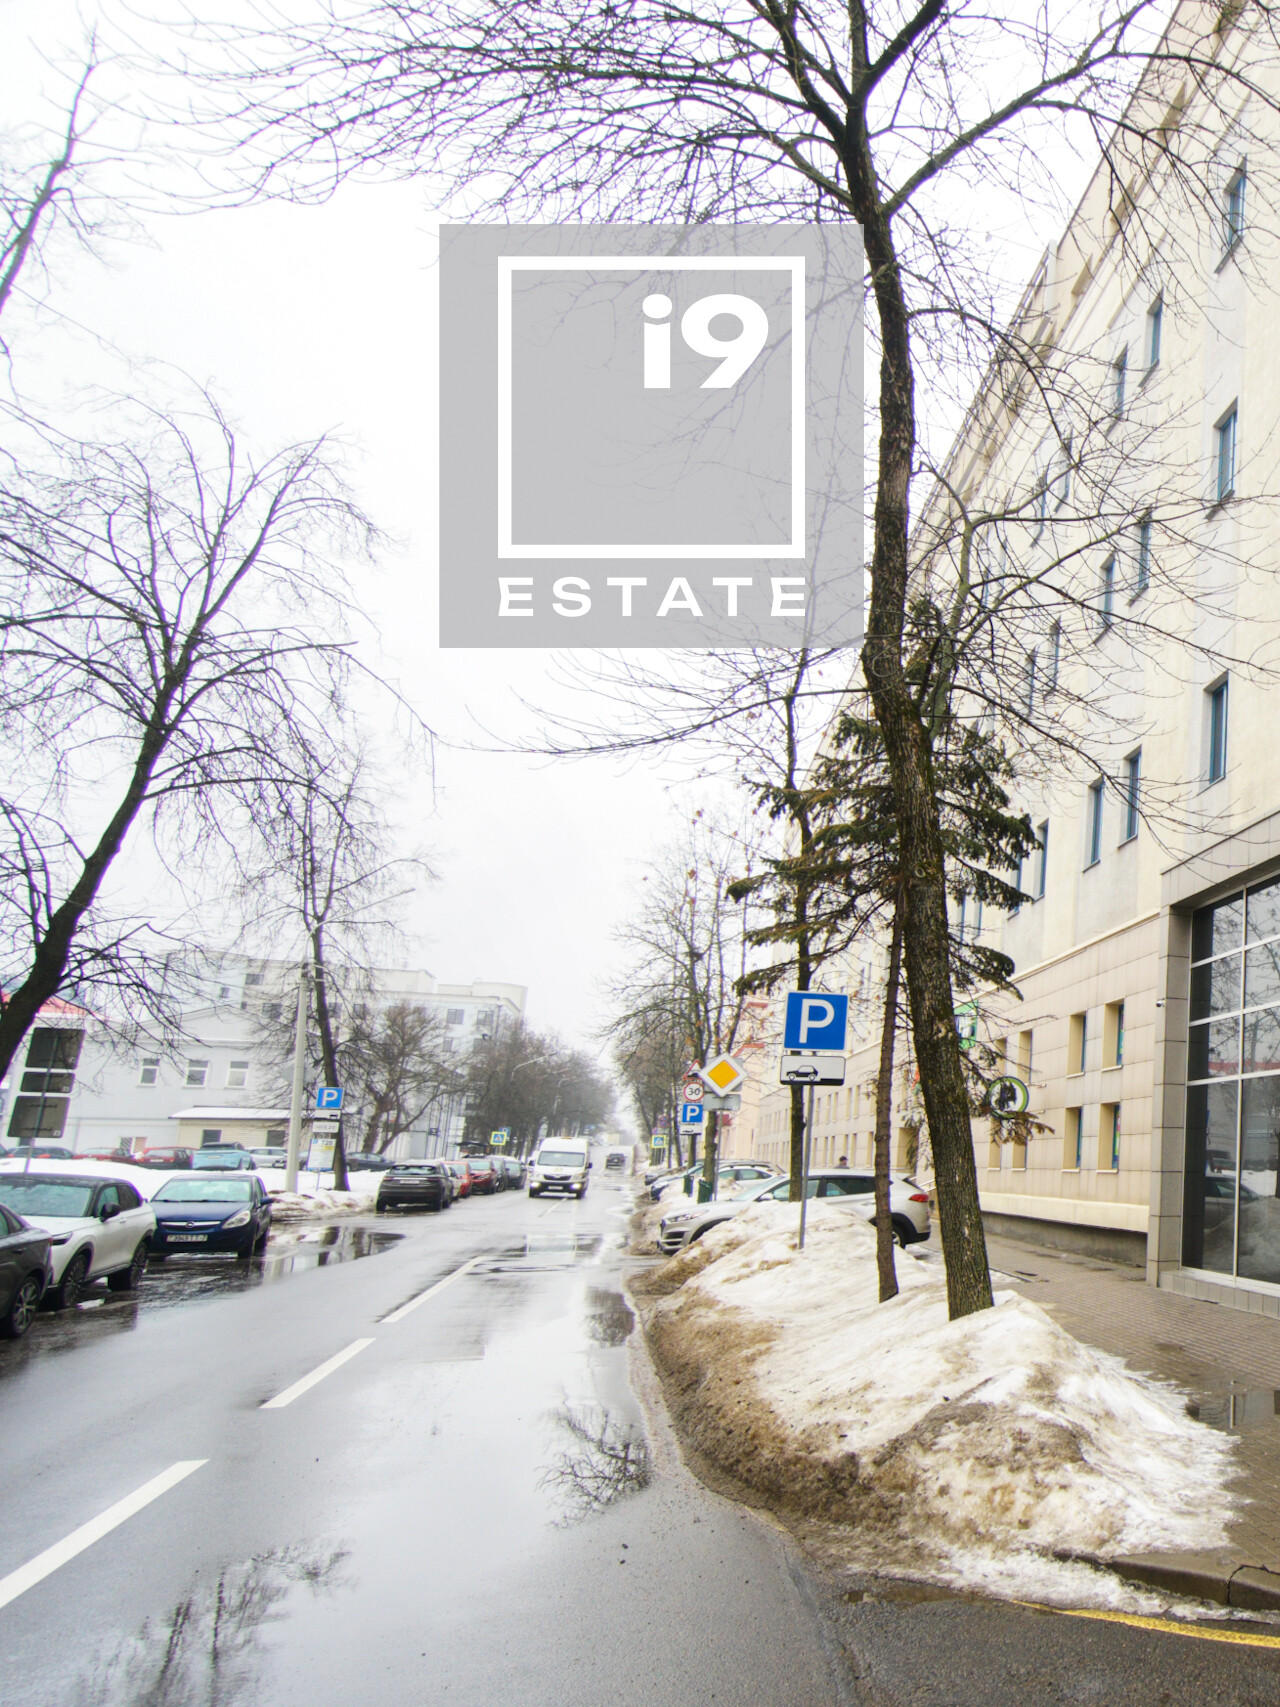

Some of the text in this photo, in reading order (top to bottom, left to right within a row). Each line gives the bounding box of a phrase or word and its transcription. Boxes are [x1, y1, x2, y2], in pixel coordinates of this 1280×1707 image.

[799, 998, 835, 1044] P
[322, 1089, 338, 1106] P
[688, 1087, 700, 1096] 30
[686, 1105, 700, 1121] P
